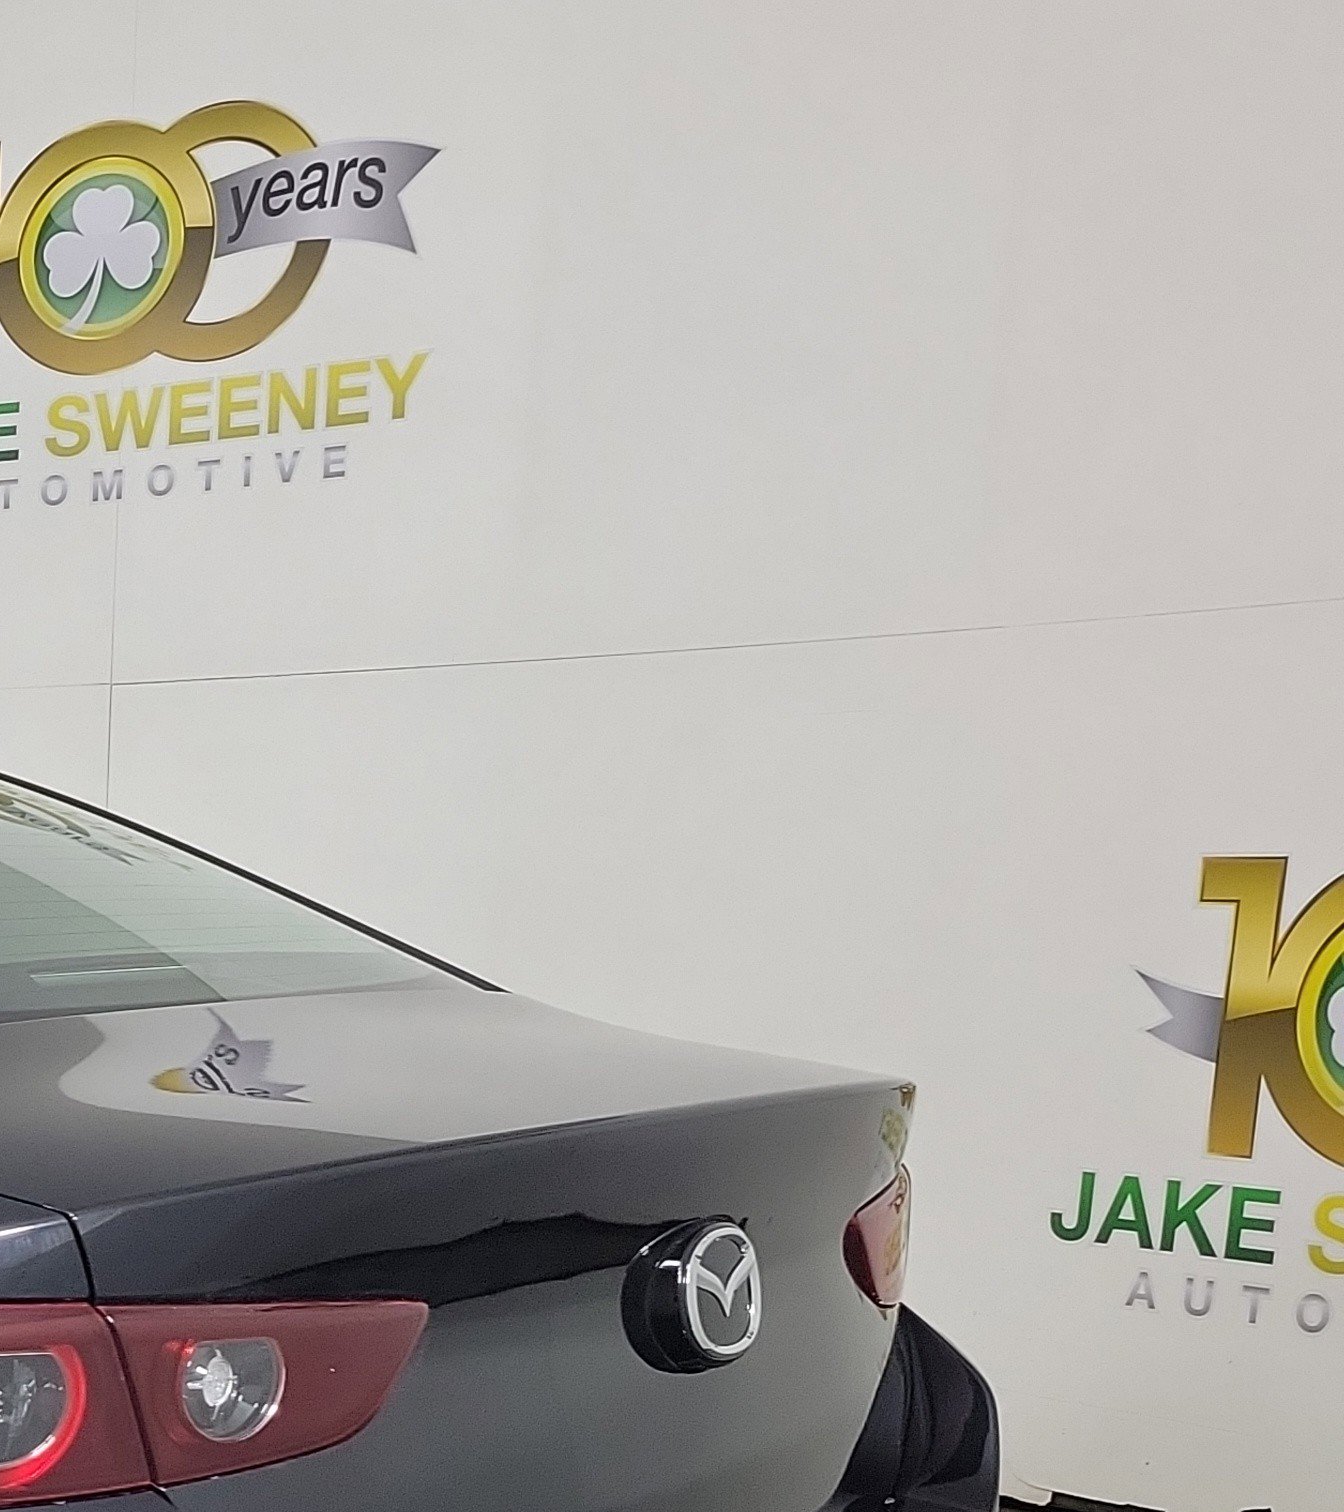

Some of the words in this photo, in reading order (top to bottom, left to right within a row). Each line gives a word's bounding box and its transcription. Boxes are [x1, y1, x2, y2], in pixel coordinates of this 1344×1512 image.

[227, 154, 386, 244] years
[43, 350, 431, 458] SWEENEY
[1050, 1171, 1282, 1265] JAKE
